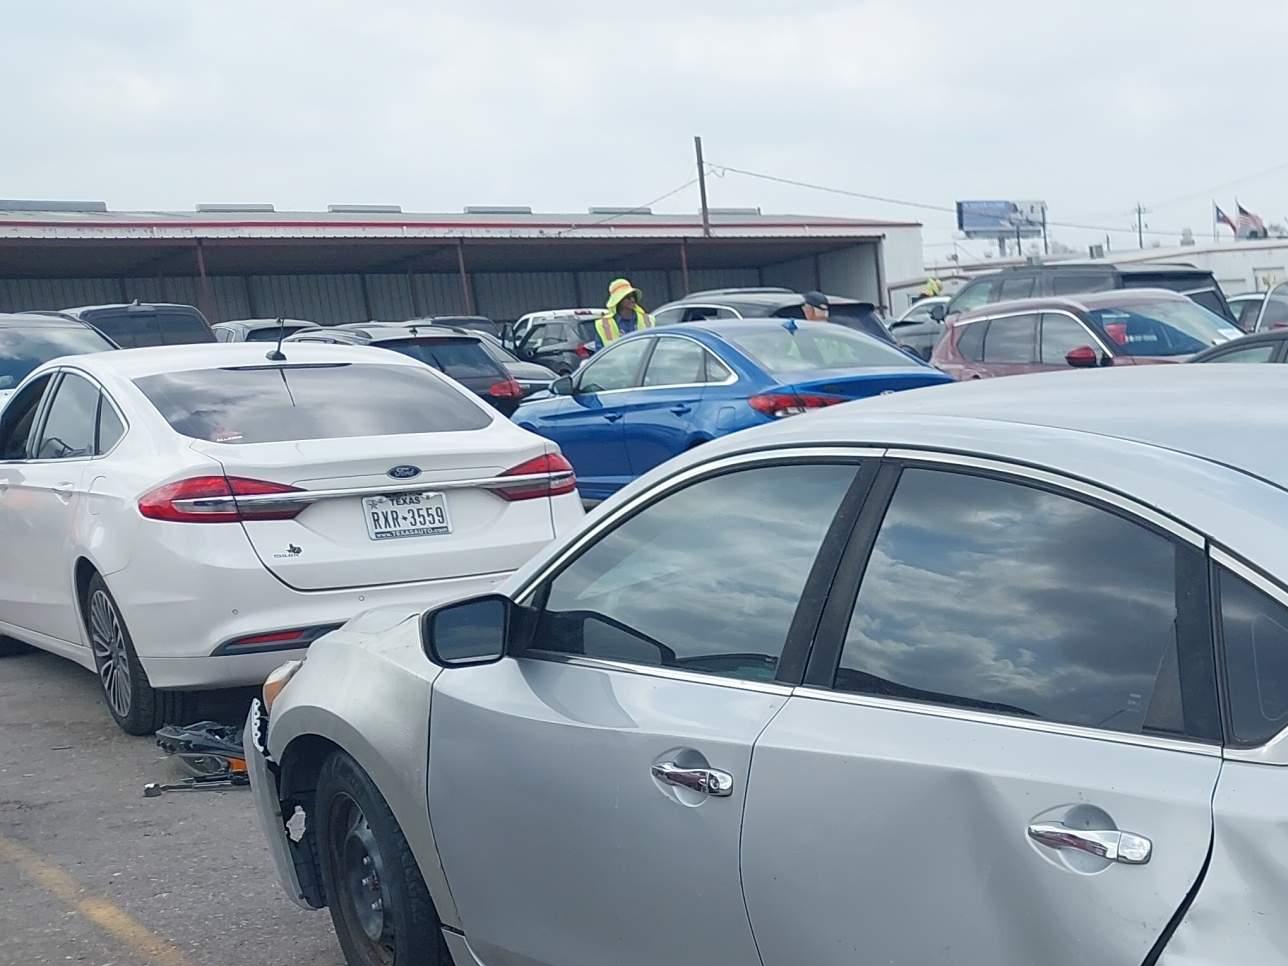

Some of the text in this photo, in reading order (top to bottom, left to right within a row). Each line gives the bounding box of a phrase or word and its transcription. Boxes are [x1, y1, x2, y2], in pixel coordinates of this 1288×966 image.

[390, 496, 421, 506] TEXAS
[371, 506, 445, 530] RXR 3559
